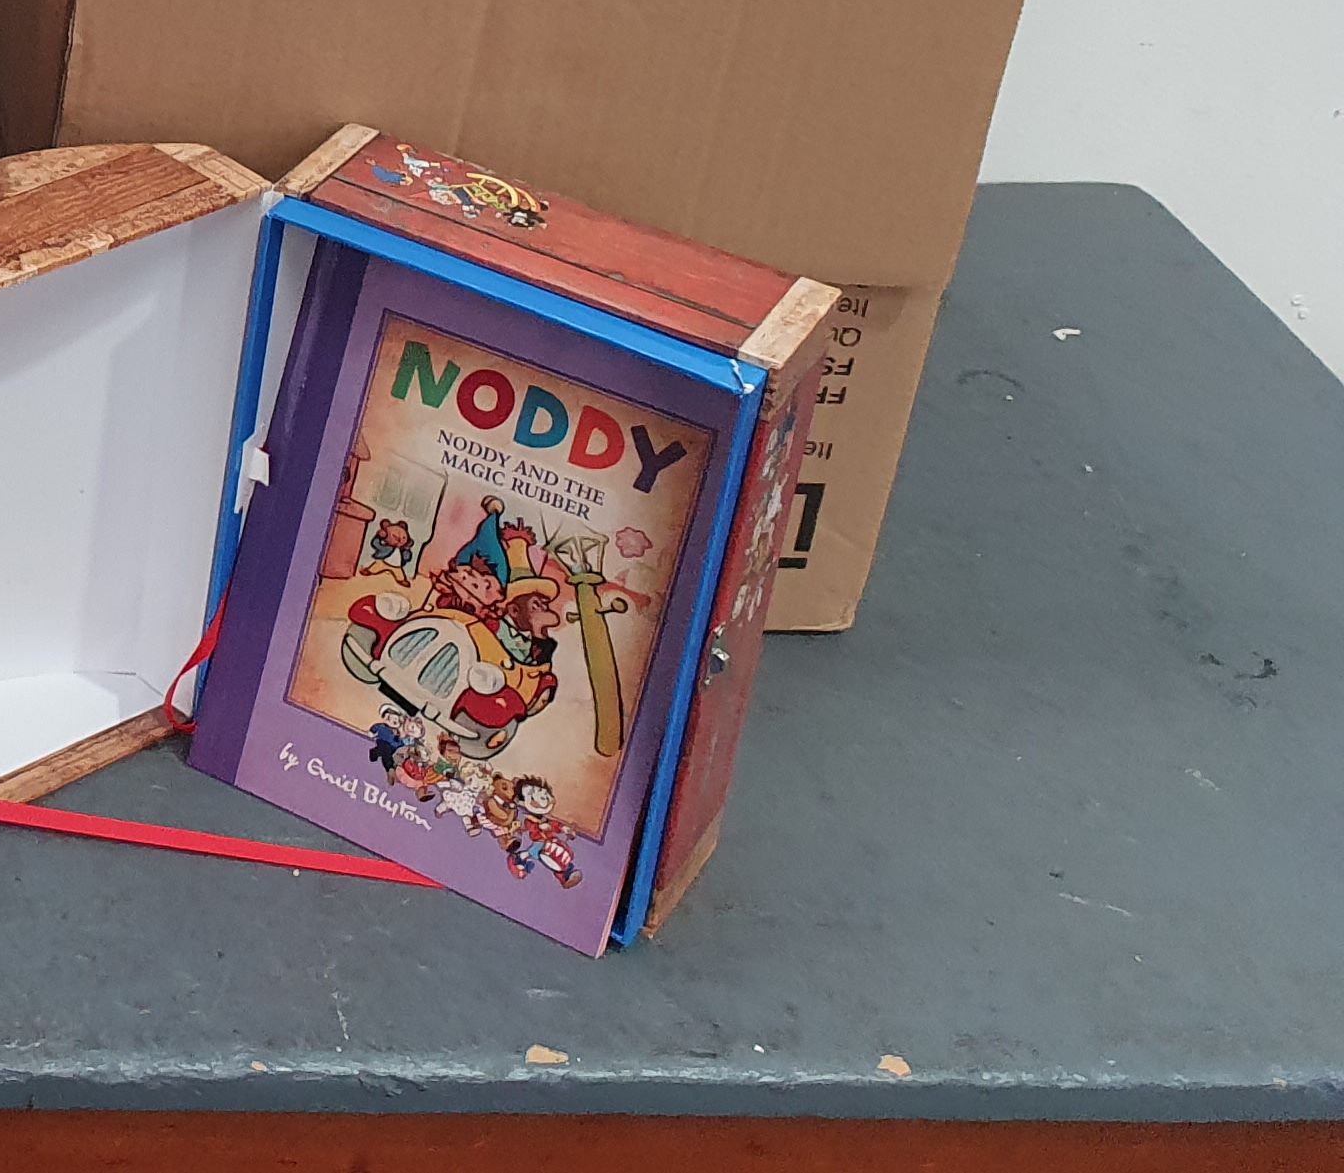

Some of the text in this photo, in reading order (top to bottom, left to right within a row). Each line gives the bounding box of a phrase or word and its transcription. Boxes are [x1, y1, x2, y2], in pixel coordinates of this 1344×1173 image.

[391, 340, 687, 493] NODDY
[438, 428, 605, 507] NODDY AND THE
[440, 449, 592, 521] MAGIC RUBBER
[279, 742, 433, 832] by Enid Blyton
